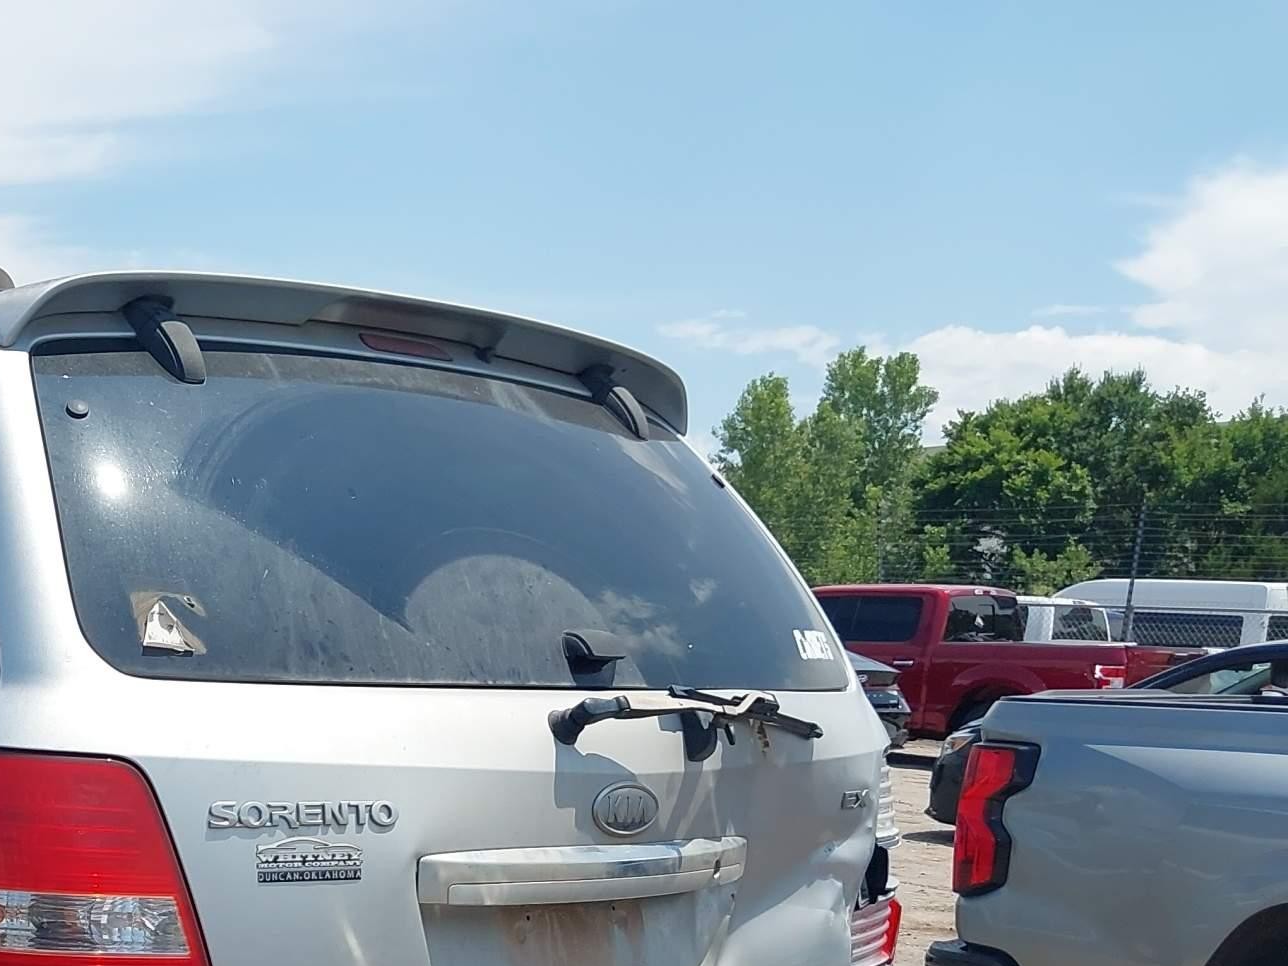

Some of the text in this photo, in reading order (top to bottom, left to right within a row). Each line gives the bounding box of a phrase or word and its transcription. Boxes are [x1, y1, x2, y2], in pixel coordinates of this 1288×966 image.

[606, 794, 650, 825] KIA
[841, 789, 870, 810] EX
[208, 799, 399, 829] SORENTO
[257, 851, 363, 863] WHITNEY
[258, 859, 363, 869] MOTOR COMPANY
